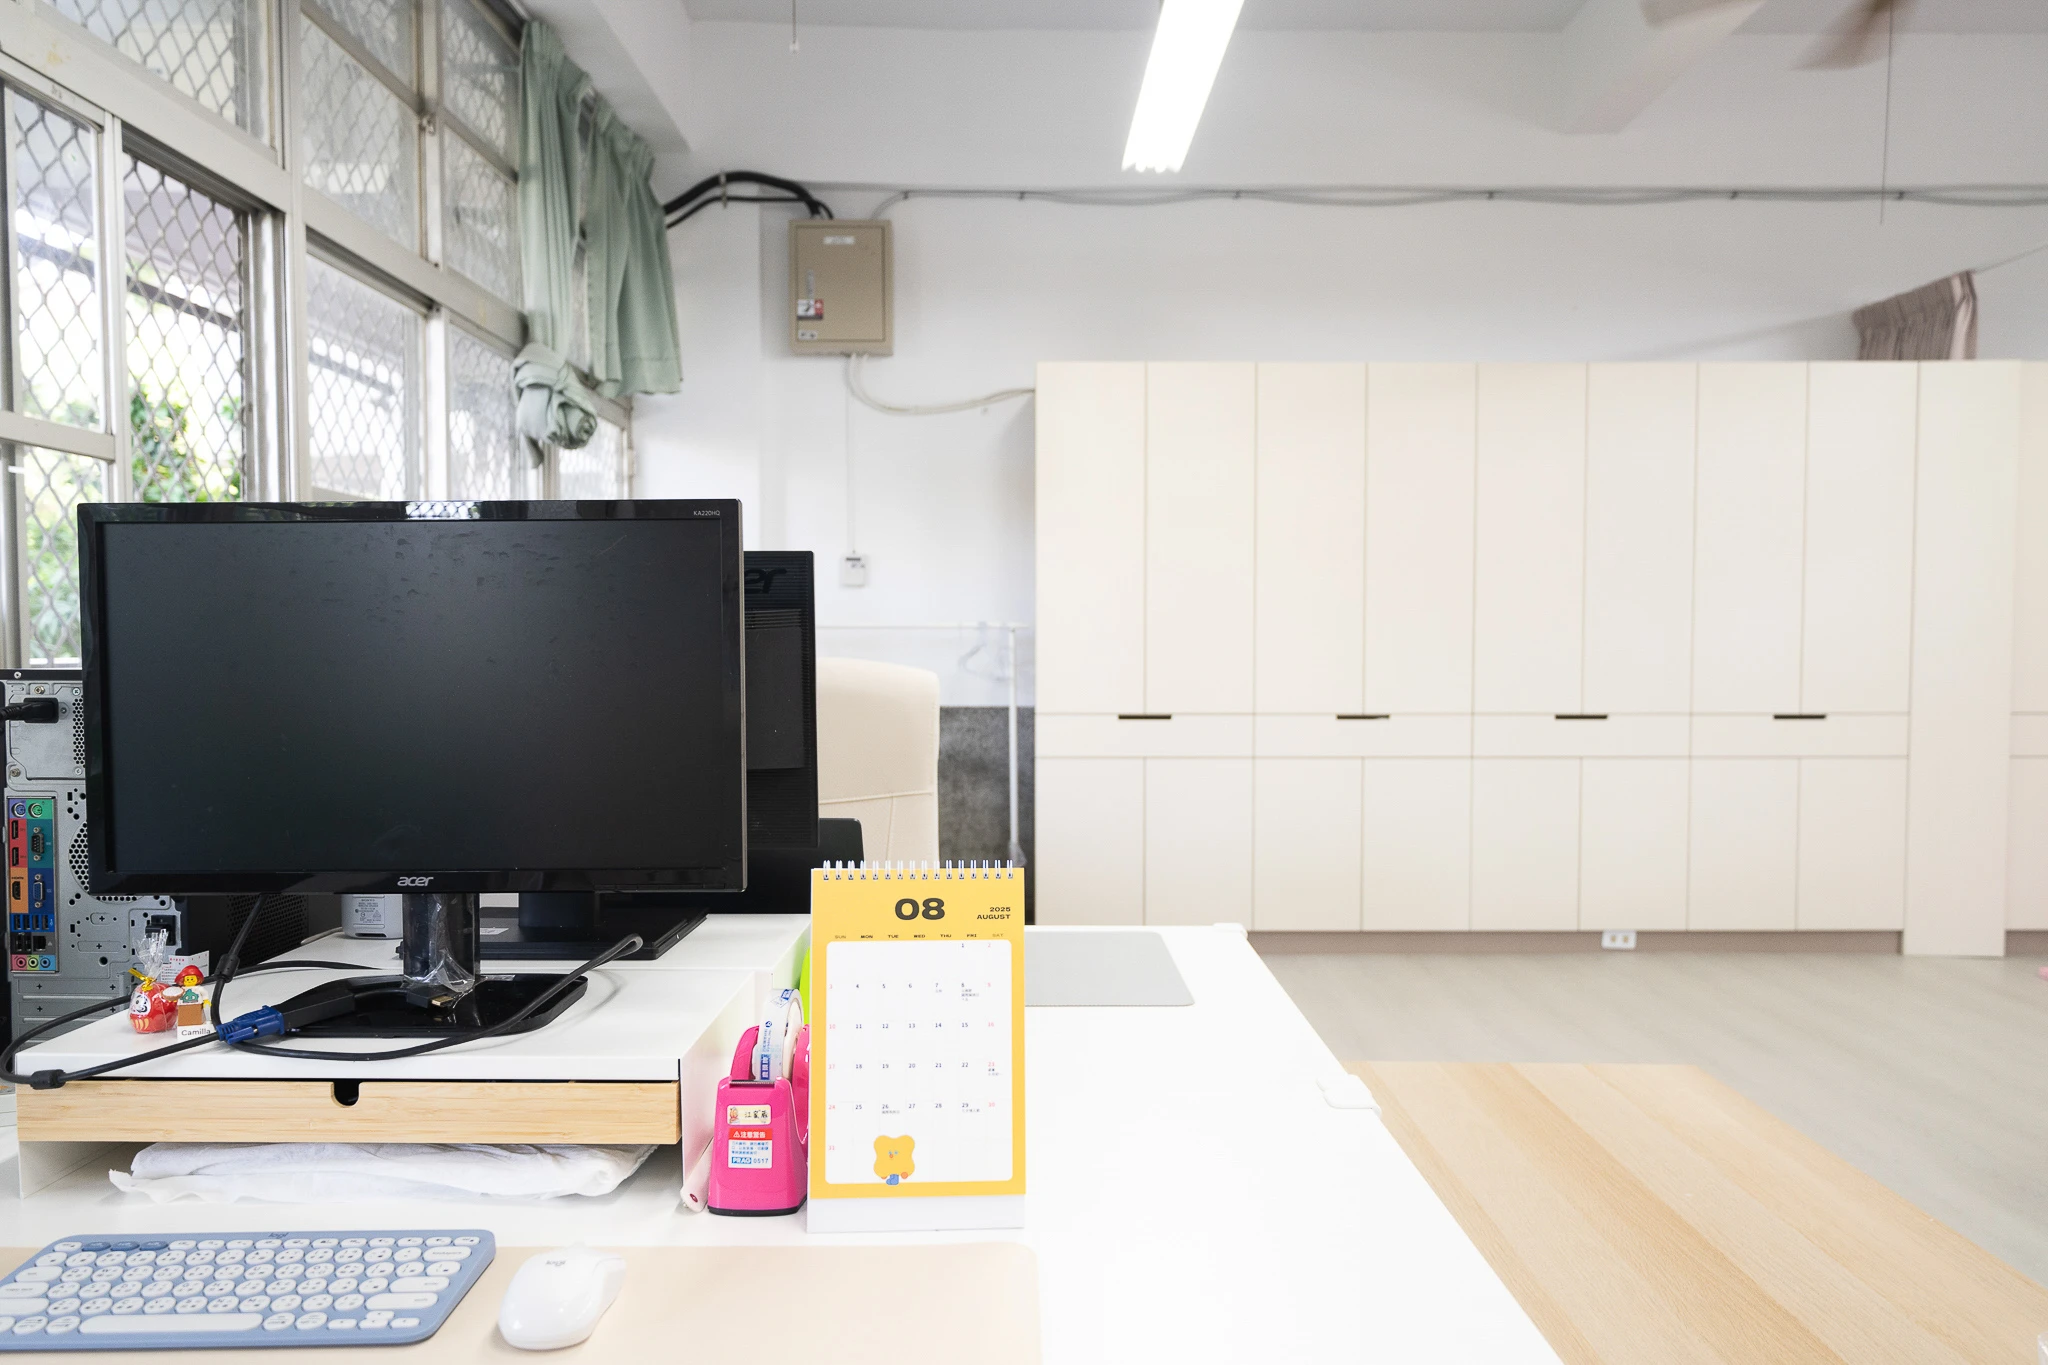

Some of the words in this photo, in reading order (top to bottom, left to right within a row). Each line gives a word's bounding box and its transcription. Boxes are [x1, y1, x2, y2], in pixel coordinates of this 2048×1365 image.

[397, 876, 434, 886] acer
[895, 898, 945, 920] 08
[181, 1028, 211, 1036] Camilla
